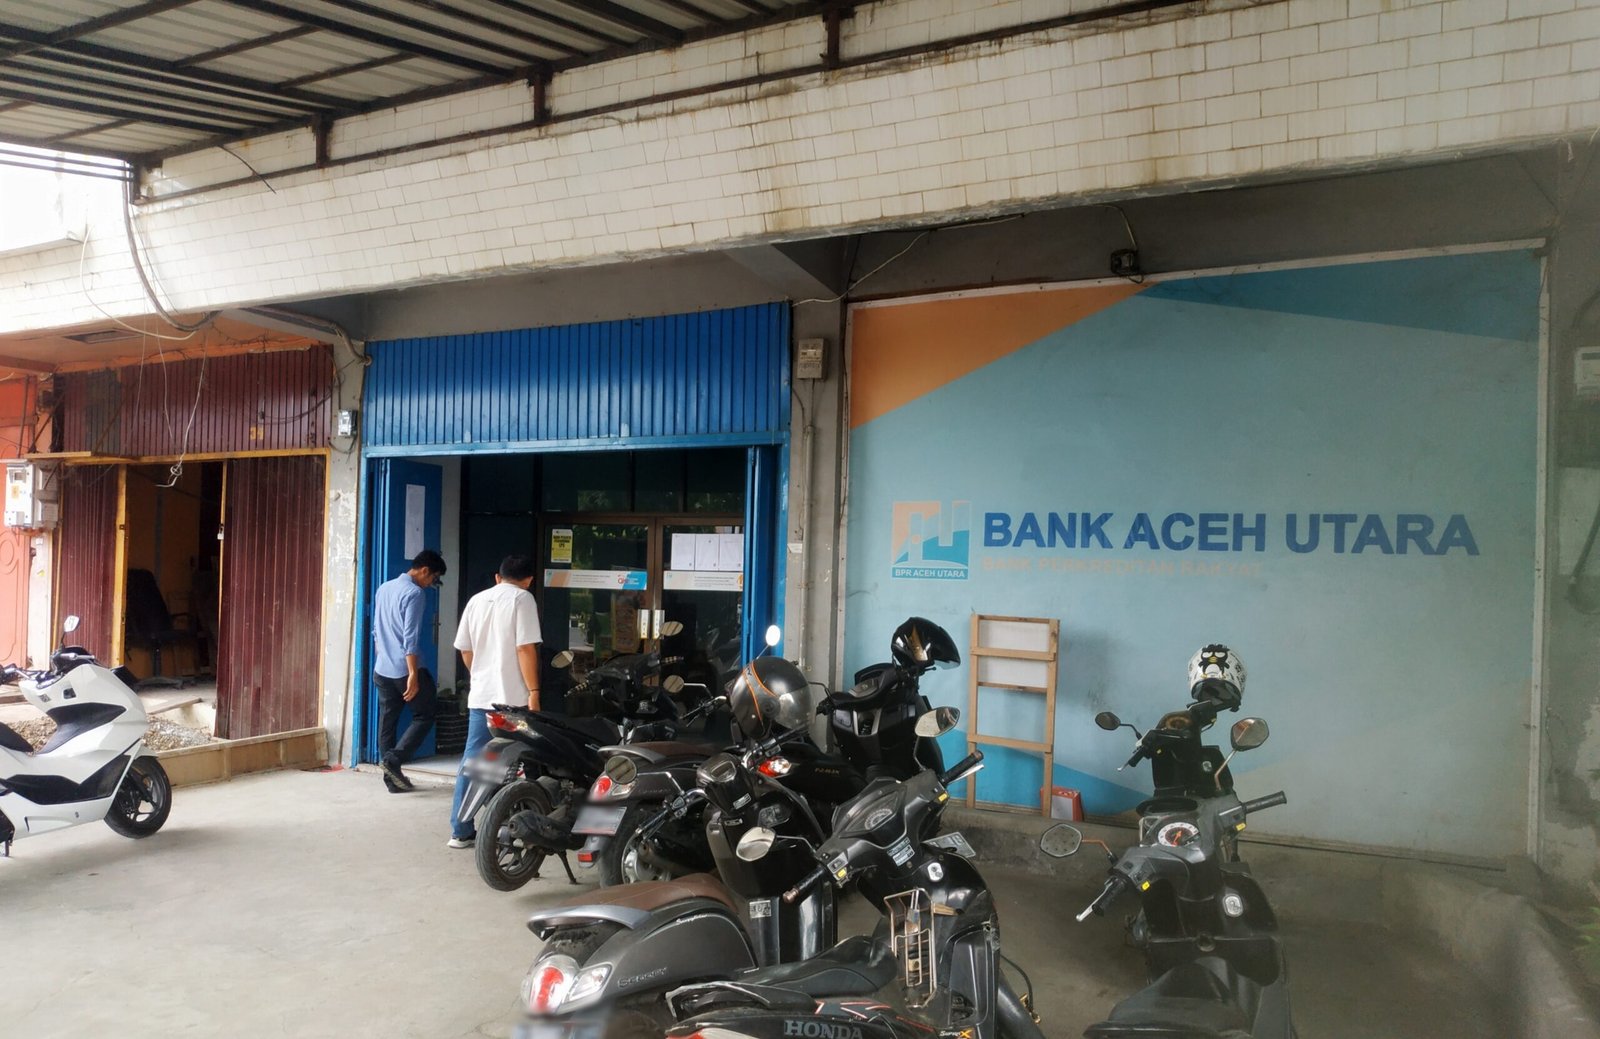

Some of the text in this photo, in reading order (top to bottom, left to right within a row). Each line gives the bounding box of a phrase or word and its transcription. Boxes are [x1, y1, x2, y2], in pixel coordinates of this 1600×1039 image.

[983, 512, 1480, 556] BANK ACEH UTARA
[895, 569, 965, 578] BPR ACEH UTARA
[784, 1019, 864, 1039] HONDA
